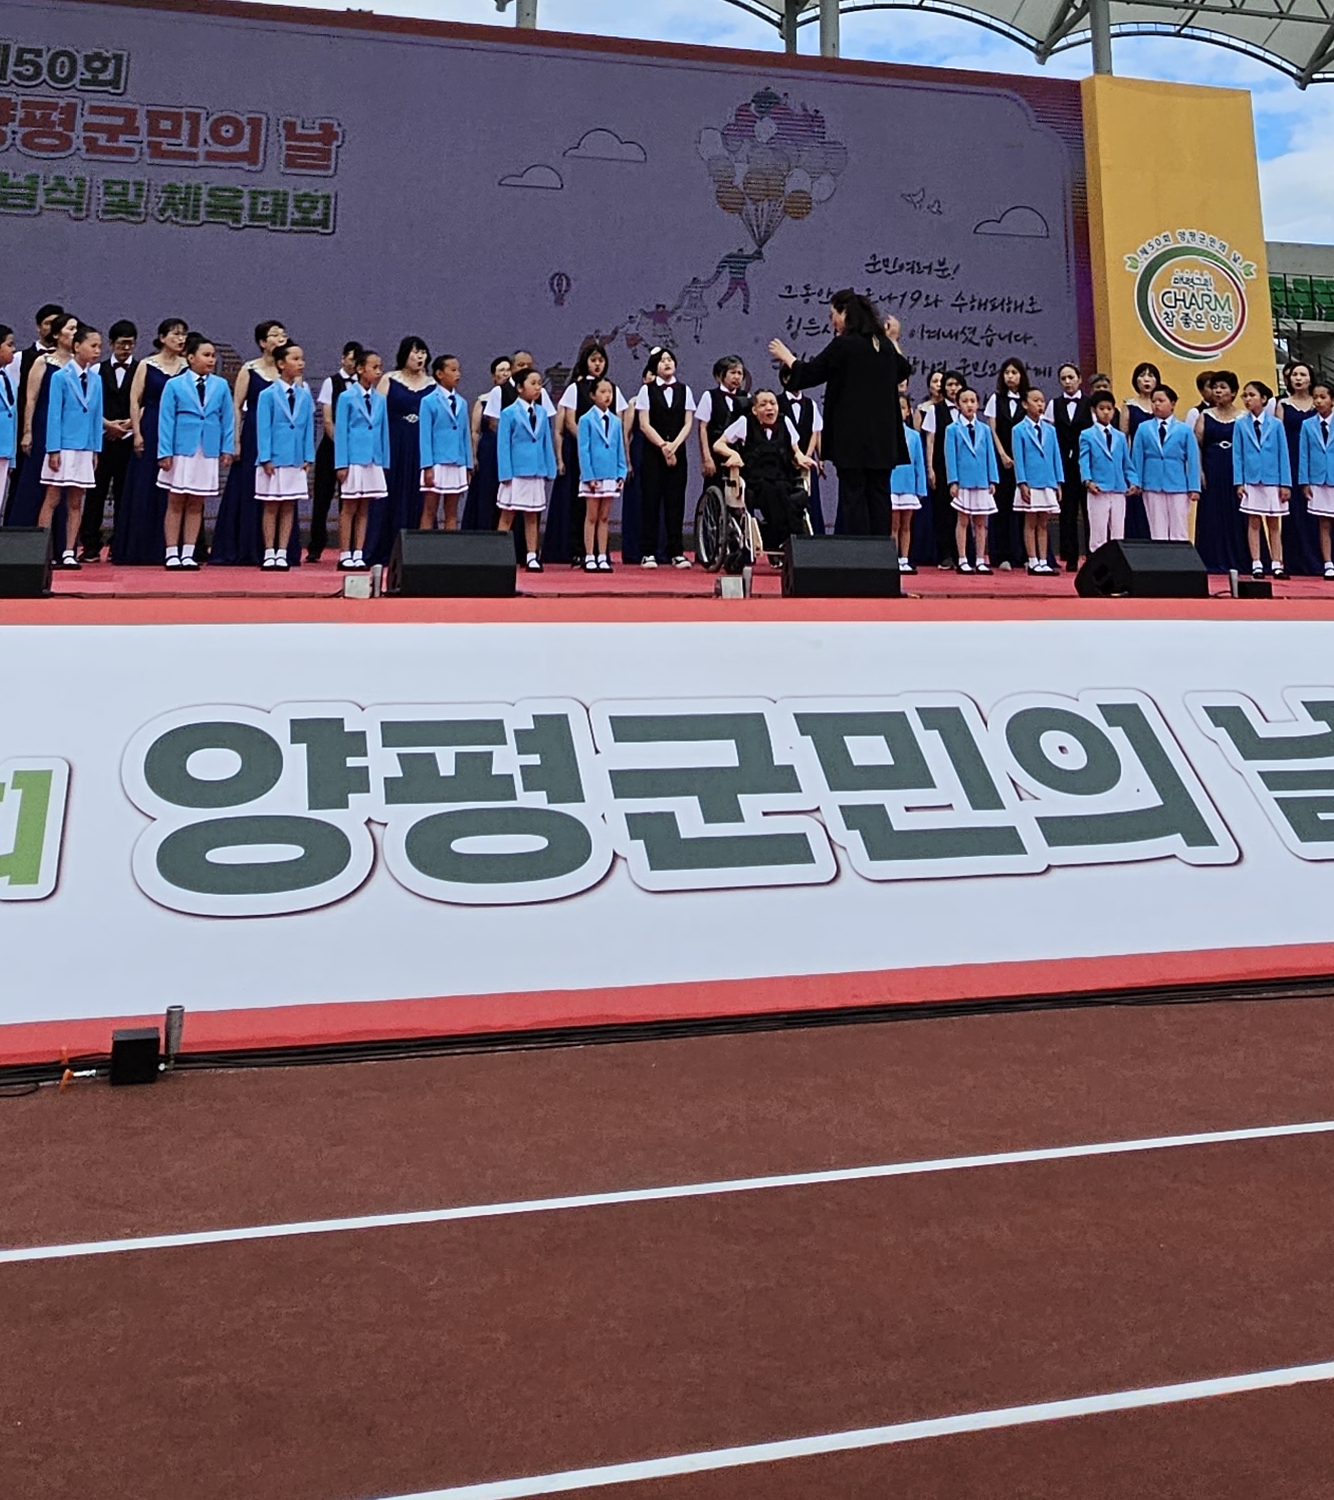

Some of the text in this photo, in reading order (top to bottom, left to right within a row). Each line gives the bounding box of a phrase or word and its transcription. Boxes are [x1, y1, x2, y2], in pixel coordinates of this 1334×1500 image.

[280, 118, 341, 171] 날
[100, 178, 147, 221] 및
[157, 181, 335, 231] 체육대회
[1138, 233, 1172, 257] 제50회
[1177, 230, 1228, 253] 양평군민의
[848, 287, 944, 310] 로나19와
[1161, 290, 1233, 313] CHARM
[1163, 310, 1234, 331] 참 좋은 양평
[141, 701, 1221, 896] 양평군민의
